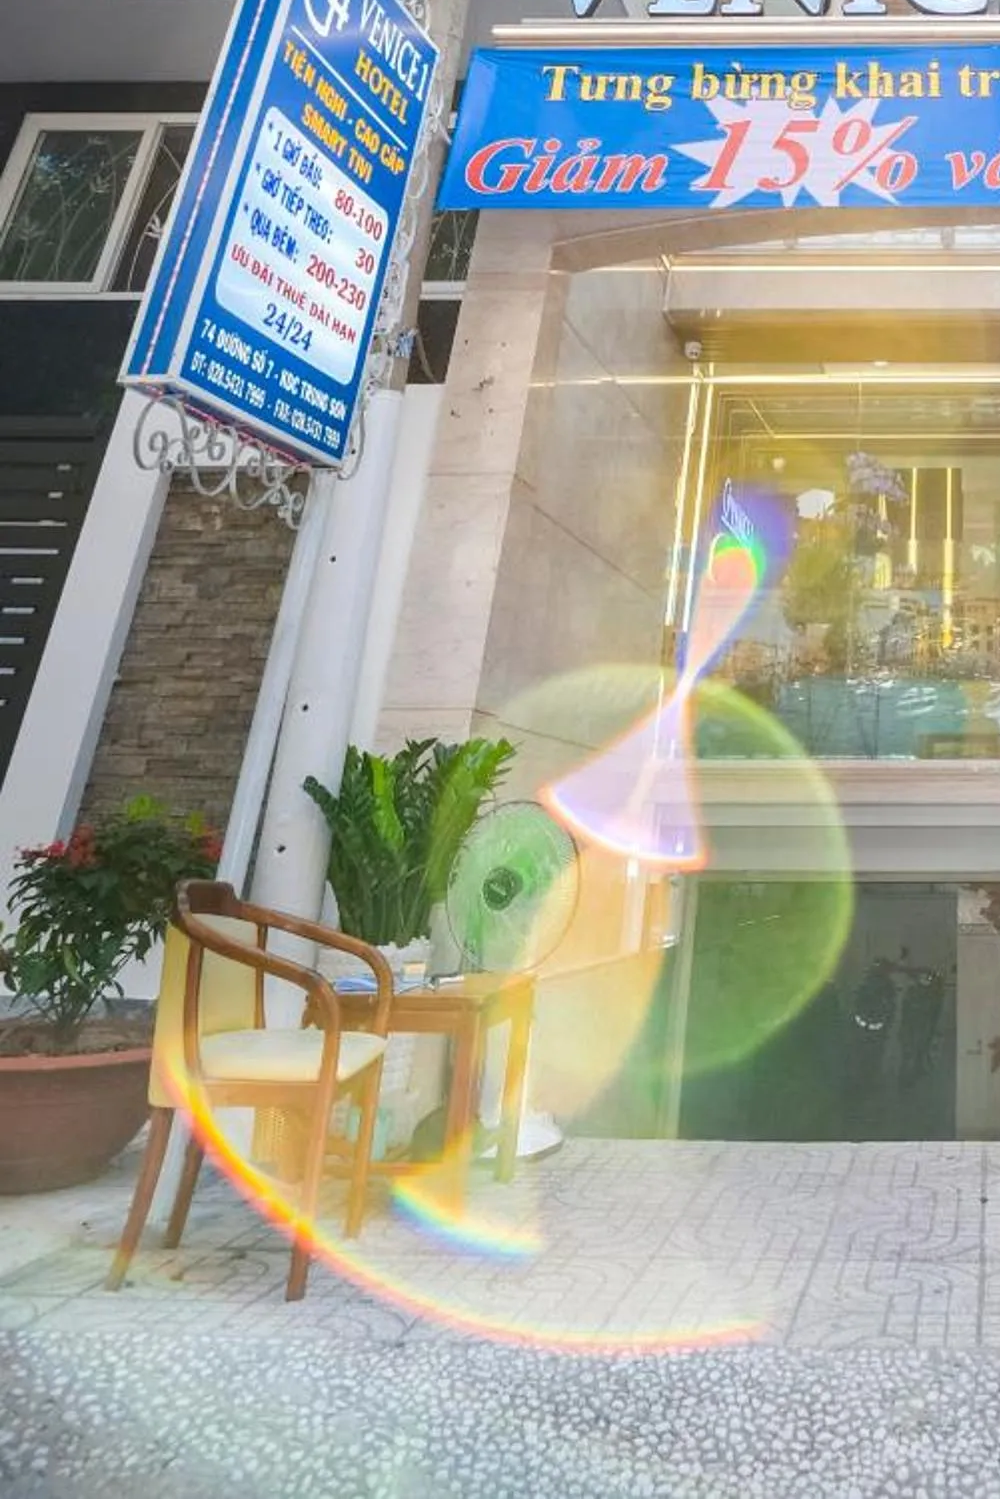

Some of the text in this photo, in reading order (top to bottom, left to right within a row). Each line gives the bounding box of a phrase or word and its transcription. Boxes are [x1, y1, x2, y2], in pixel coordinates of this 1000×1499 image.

[355, 47, 408, 125] HOTEL
[691, 61, 820, 110] bừng
[835, 61, 941, 98] khai
[302, 103, 373, 184] SMART TIVI
[355, 118, 380, 153] CAO
[465, 137, 667, 195] Giảm
[698, 116, 919, 193] 15%
[335, 189, 383, 241] 80-100
[306, 254, 367, 311] 200-230
[355, 247, 375, 275] 30
[200, 318, 217, 343] 74
[263, 303, 313, 352] 24/24
